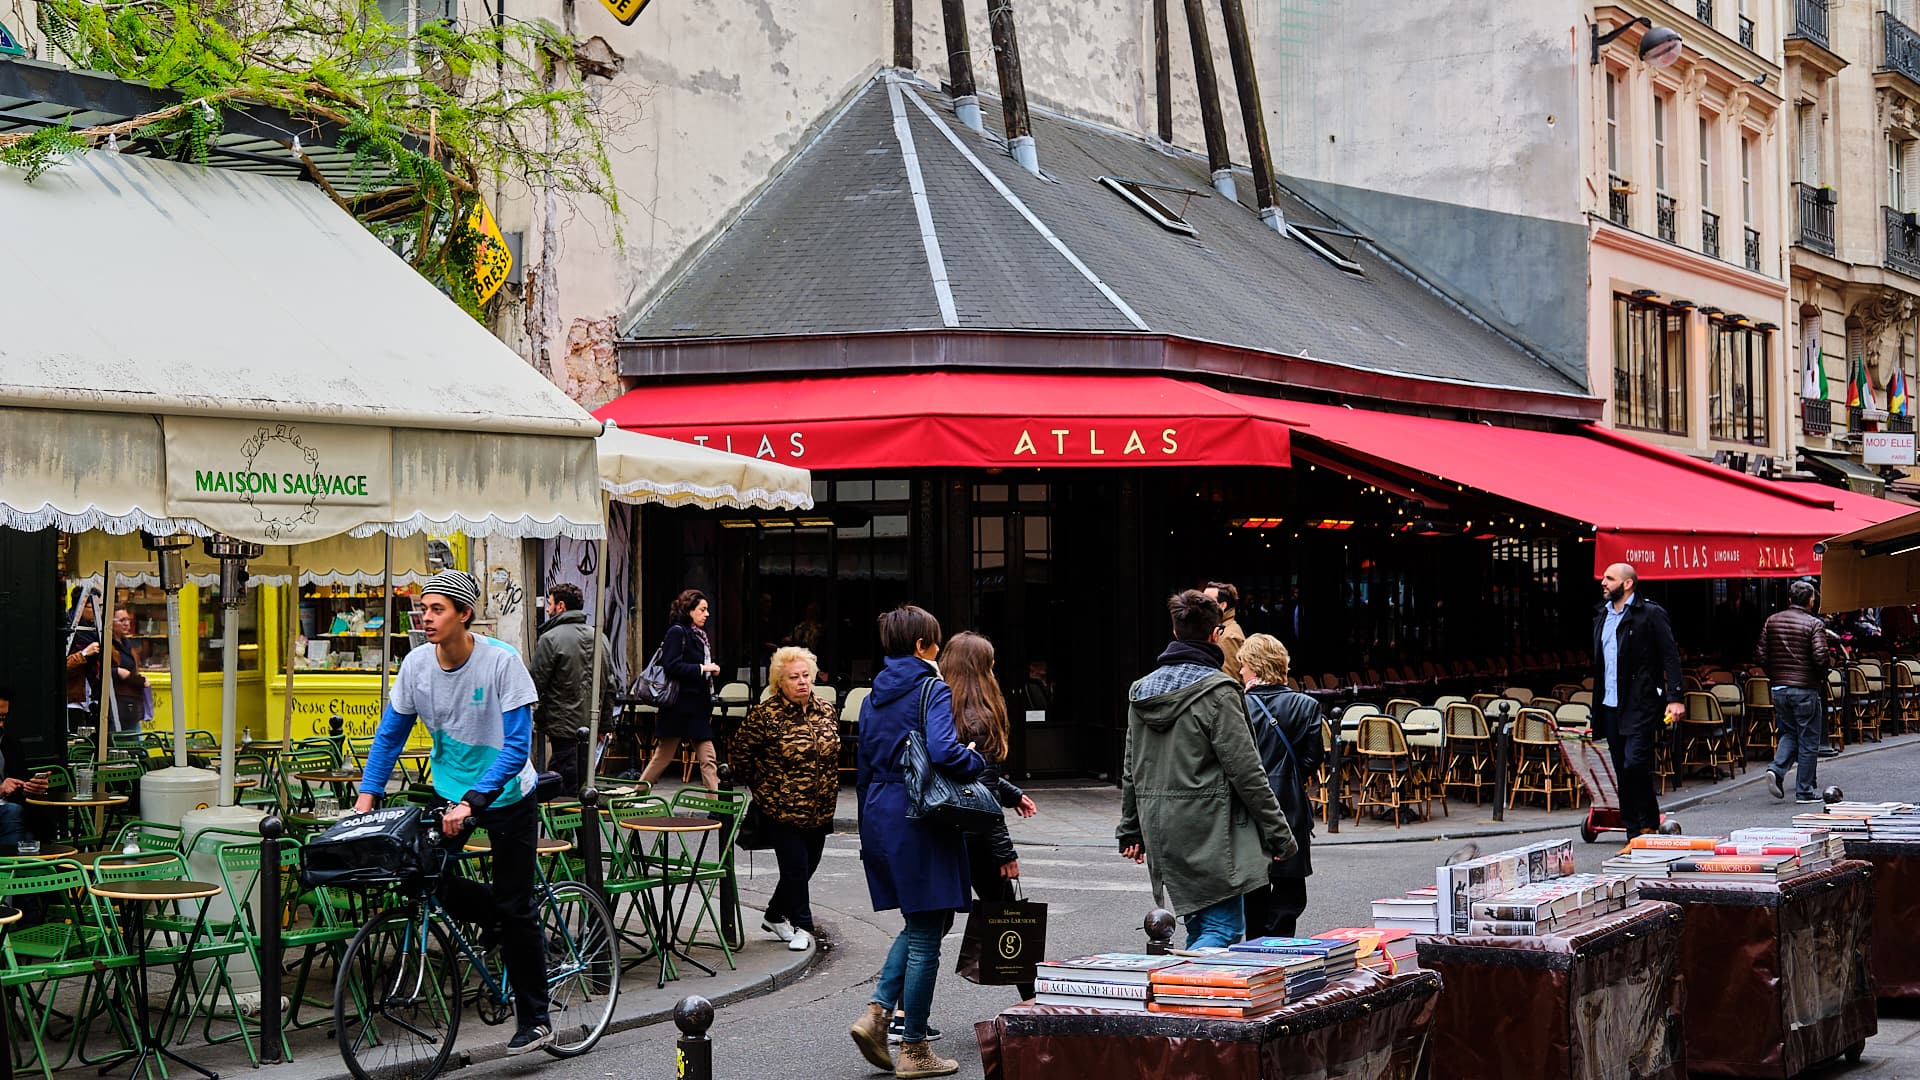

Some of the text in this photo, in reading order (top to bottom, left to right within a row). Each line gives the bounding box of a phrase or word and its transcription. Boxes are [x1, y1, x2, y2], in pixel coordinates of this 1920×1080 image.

[671, 431, 805, 459] TLAS
[1013, 428, 1178, 455] ATLAS
[1890, 438, 1912, 448] ELLE
[195, 470, 369, 496] MAISON SAUVAGE
[1626, 549, 1656, 563] COMPTOIR
[1663, 545, 1708, 569] ATLAS
[1713, 550, 1740, 562] LIMONADE
[1758, 547, 1795, 568] ATLAS
[329, 698, 380, 720] Etrangè
[342, 810, 406, 827] deliveroo
[1694, 863, 1720, 872] SMALL
[1721, 864, 1752, 872] WORLD
[1005, 935, 1017, 954] g
